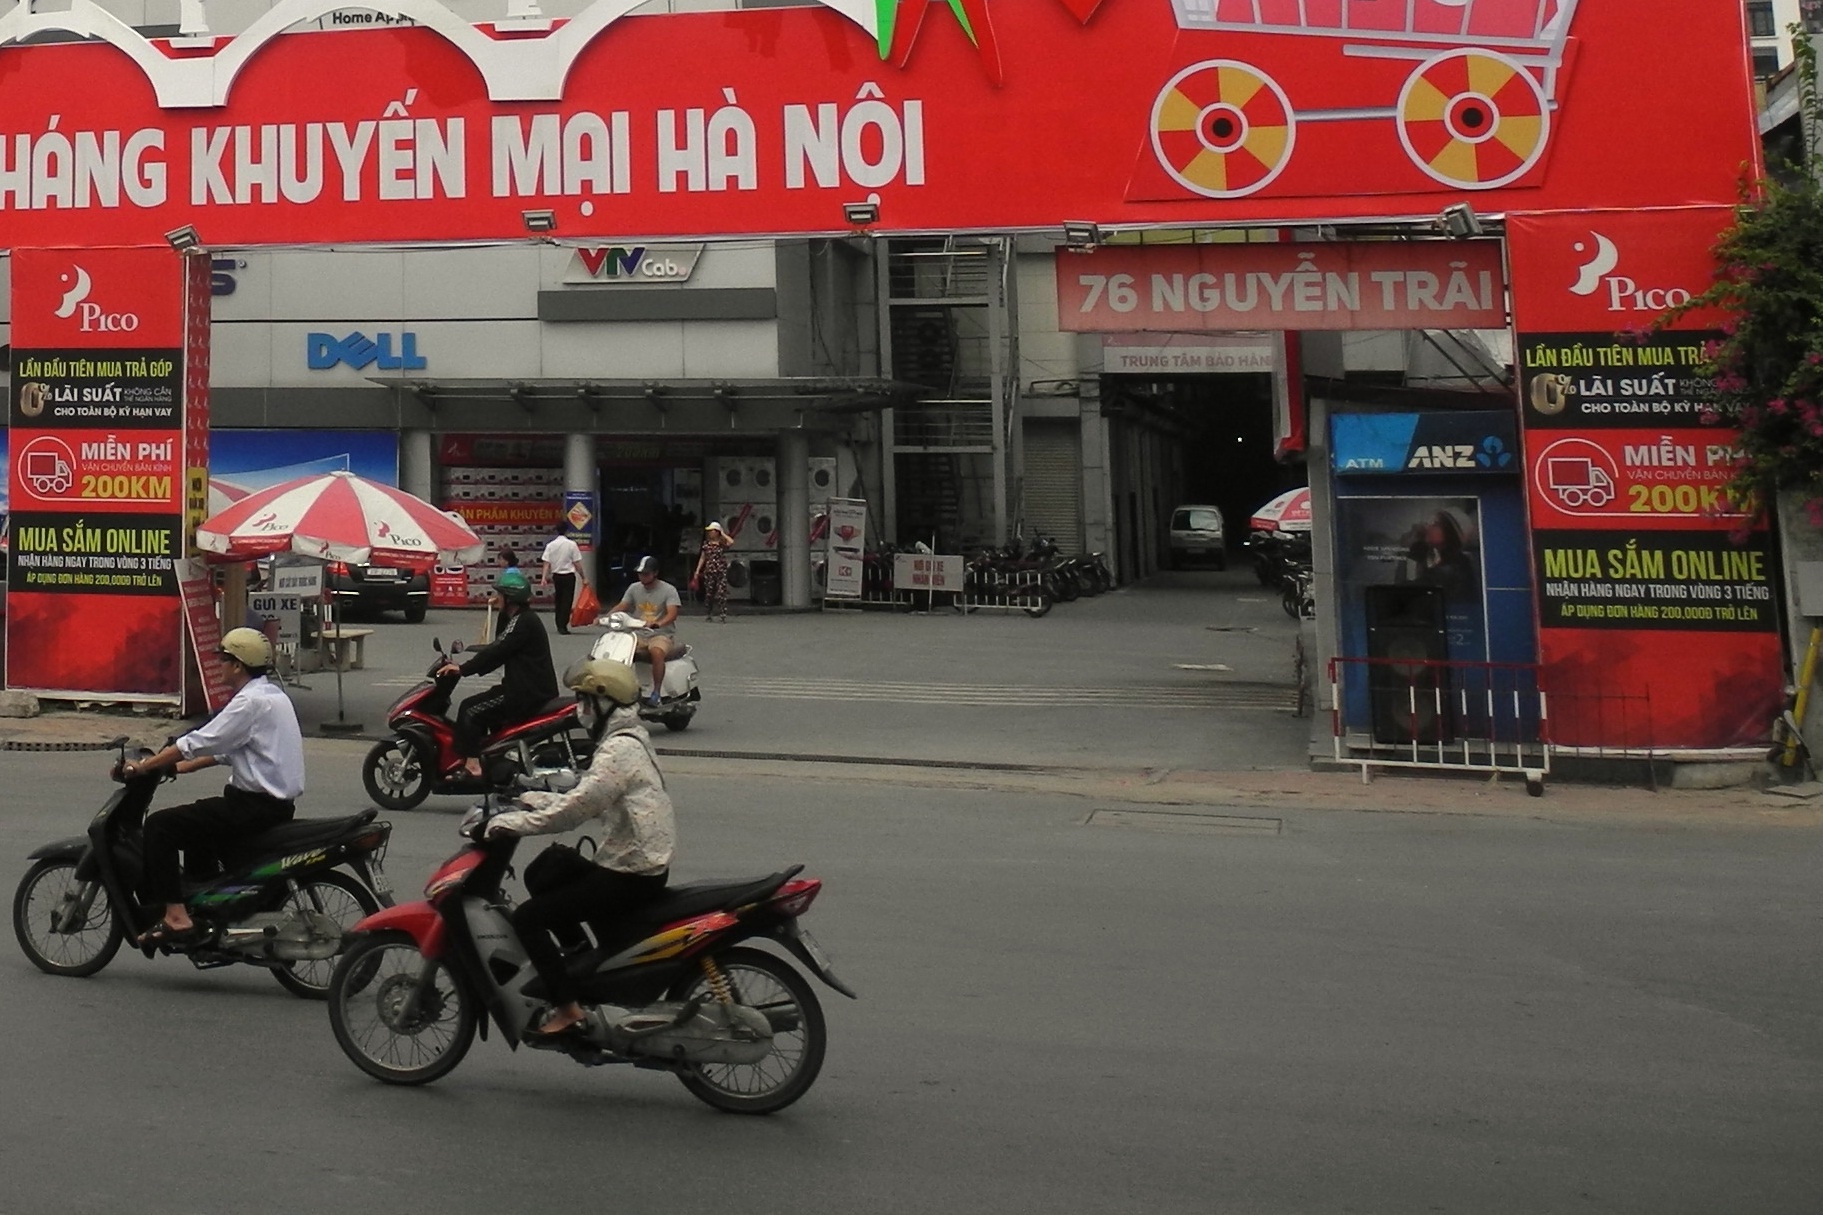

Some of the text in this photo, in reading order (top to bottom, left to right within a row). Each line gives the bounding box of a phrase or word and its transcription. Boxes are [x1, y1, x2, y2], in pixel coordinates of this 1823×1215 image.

[332, 11, 373, 25] Home
[190, 88, 467, 207] KHUYẾN
[490, 110, 631, 218] MẠI
[657, 87, 758, 191] HÀ
[783, 81, 926, 208] NỘI
[577, 247, 646, 277] VTV
[1079, 252, 1494, 314] 76 NGUYỄN TRÃI
[1605, 276, 1691, 312] Pico
[80, 302, 139, 332] Pico
[307, 331, 427, 370] DELL
[1121, 352, 1273, 367] TRUNG TÂM BẢO HÀN
[1526, 343, 1674, 367] LẦN ĐẦU TIÊN MUA
[19, 356, 41, 377] LẦN
[70, 358, 95, 377] TIÊN
[97, 362, 122, 377] MUA
[125, 357, 147, 377] TRẢ
[152, 359, 173, 377] GÓP
[54, 383, 78, 402] LÃI
[82, 382, 122, 402] SUẤT
[1530, 371, 1676, 415] 0% LÃI SUẤT
[54, 405, 172, 419] CHO TOÀN BỘ HẠN VAY
[1581, 400, 1690, 416] CHO TOÀN BỘ KỲ
[81, 434, 174, 461] MIỄN PHÍ
[1345, 445, 1476, 469] ATM ANZ
[1624, 435, 1697, 466] MIỄN
[1627, 468, 1701, 481] VẬN CHUYỂN
[81, 475, 172, 498] 200KM
[18, 519, 171, 555] MUA SẮM ONLINE
[390, 534, 422, 548] Pico
[18, 554, 172, 570] NHẬN HÀNG NGAY TRONG VÒNG 3 TIẾNG
[1544, 539, 1766, 581] MUA SẮM ONLINE
[1546, 581, 1770, 601] NHẬN HÀNG NGAY TRONG VÒNG 3 TIẾNG
[281, 598, 297, 611] XE
[1561, 603, 1575, 617] ÁP
[1630, 603, 1659, 619] HÀNG
[1737, 605, 1758, 621] LÊN
